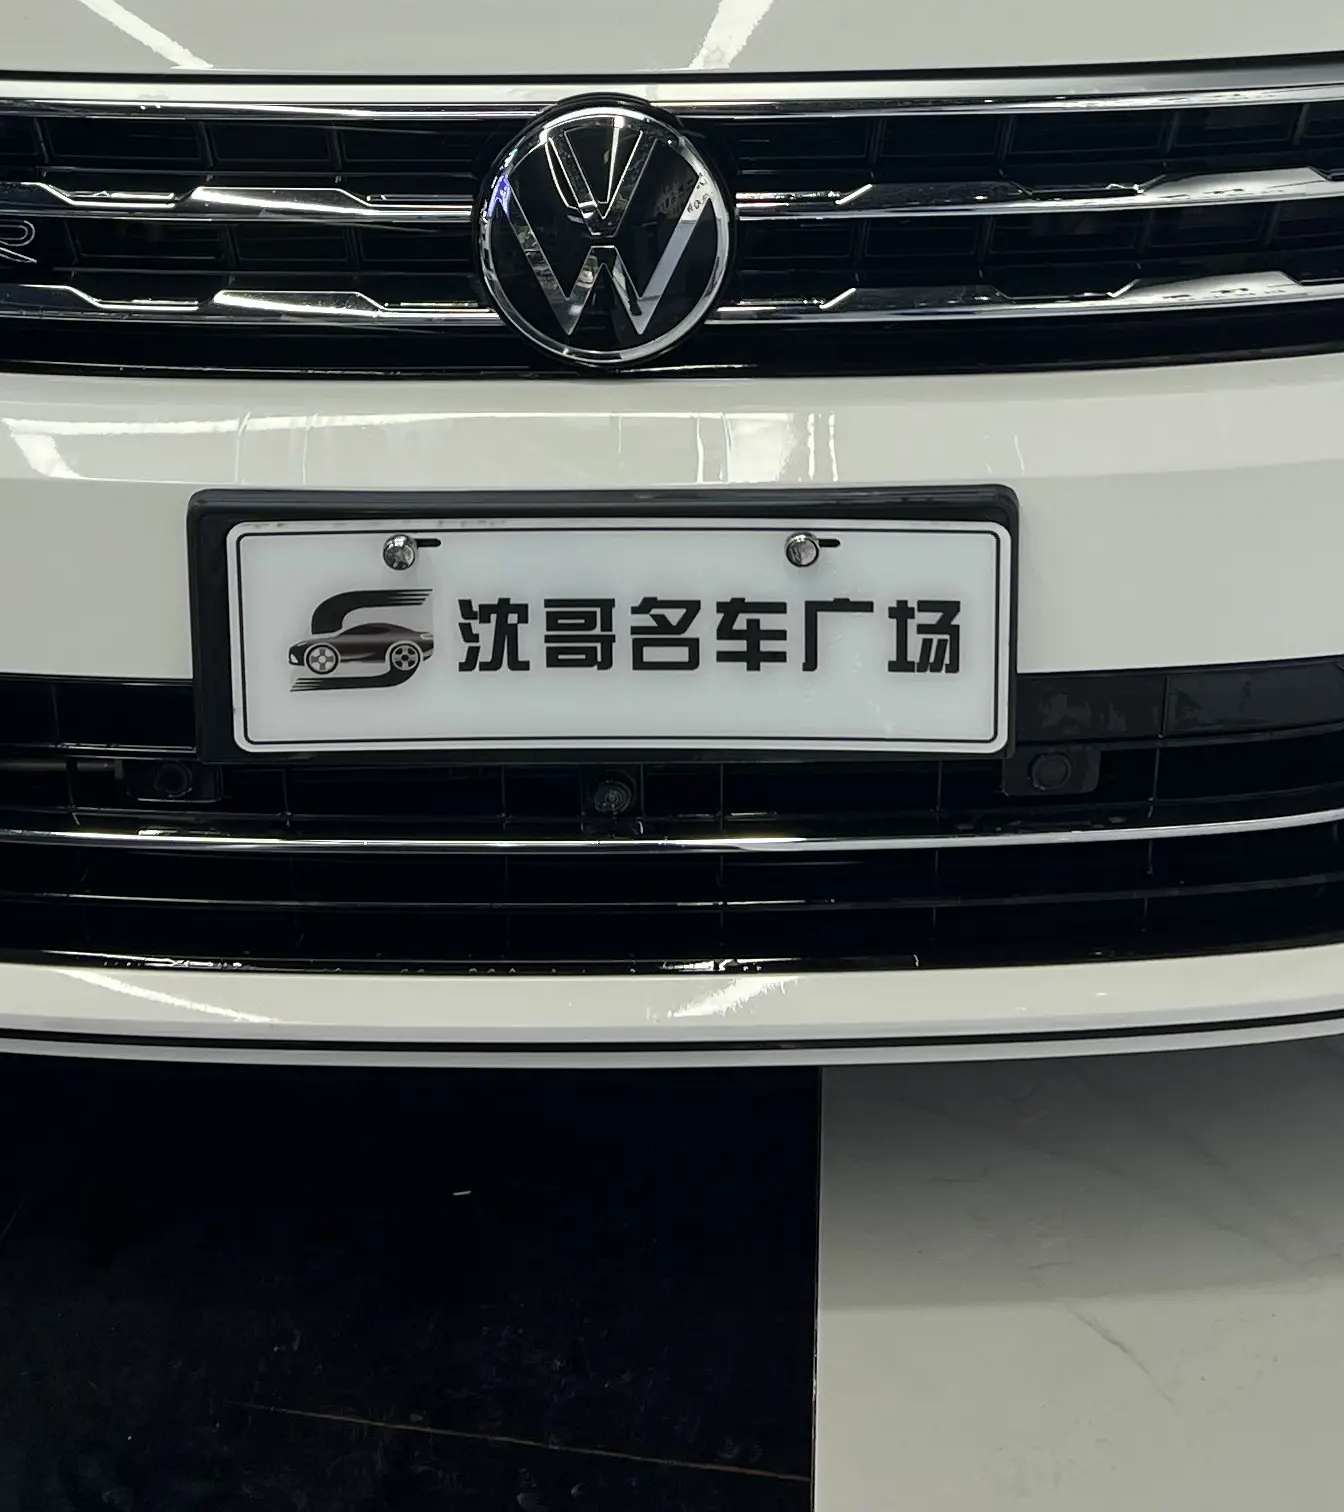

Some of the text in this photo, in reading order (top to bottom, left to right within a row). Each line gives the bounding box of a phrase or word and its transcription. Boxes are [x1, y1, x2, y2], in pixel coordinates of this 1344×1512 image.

[457, 597, 961, 673] 沈哥名车广场
